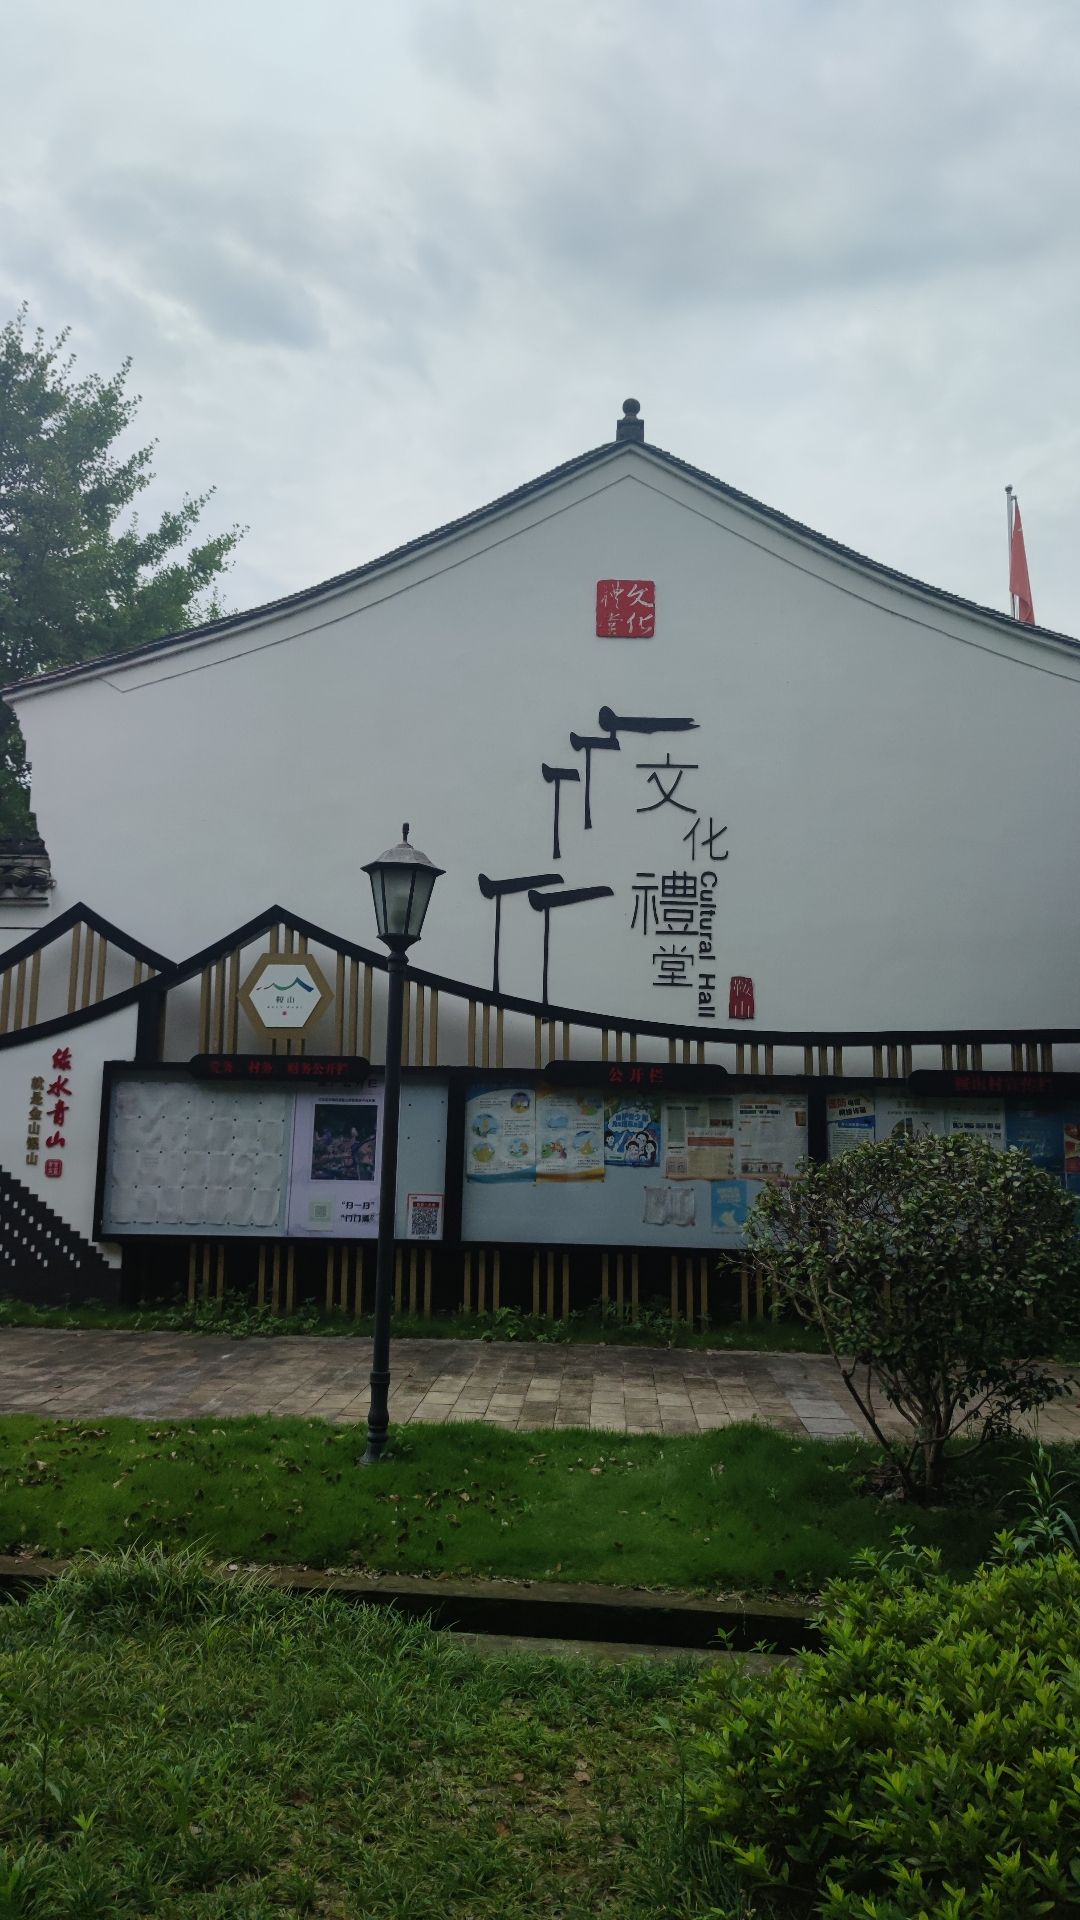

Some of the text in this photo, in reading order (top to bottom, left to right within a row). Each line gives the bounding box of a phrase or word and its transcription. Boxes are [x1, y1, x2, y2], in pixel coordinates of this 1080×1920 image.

[698, 871, 718, 1018] Cultural Hall
[608, 1065, 664, 1084] 公开栏
